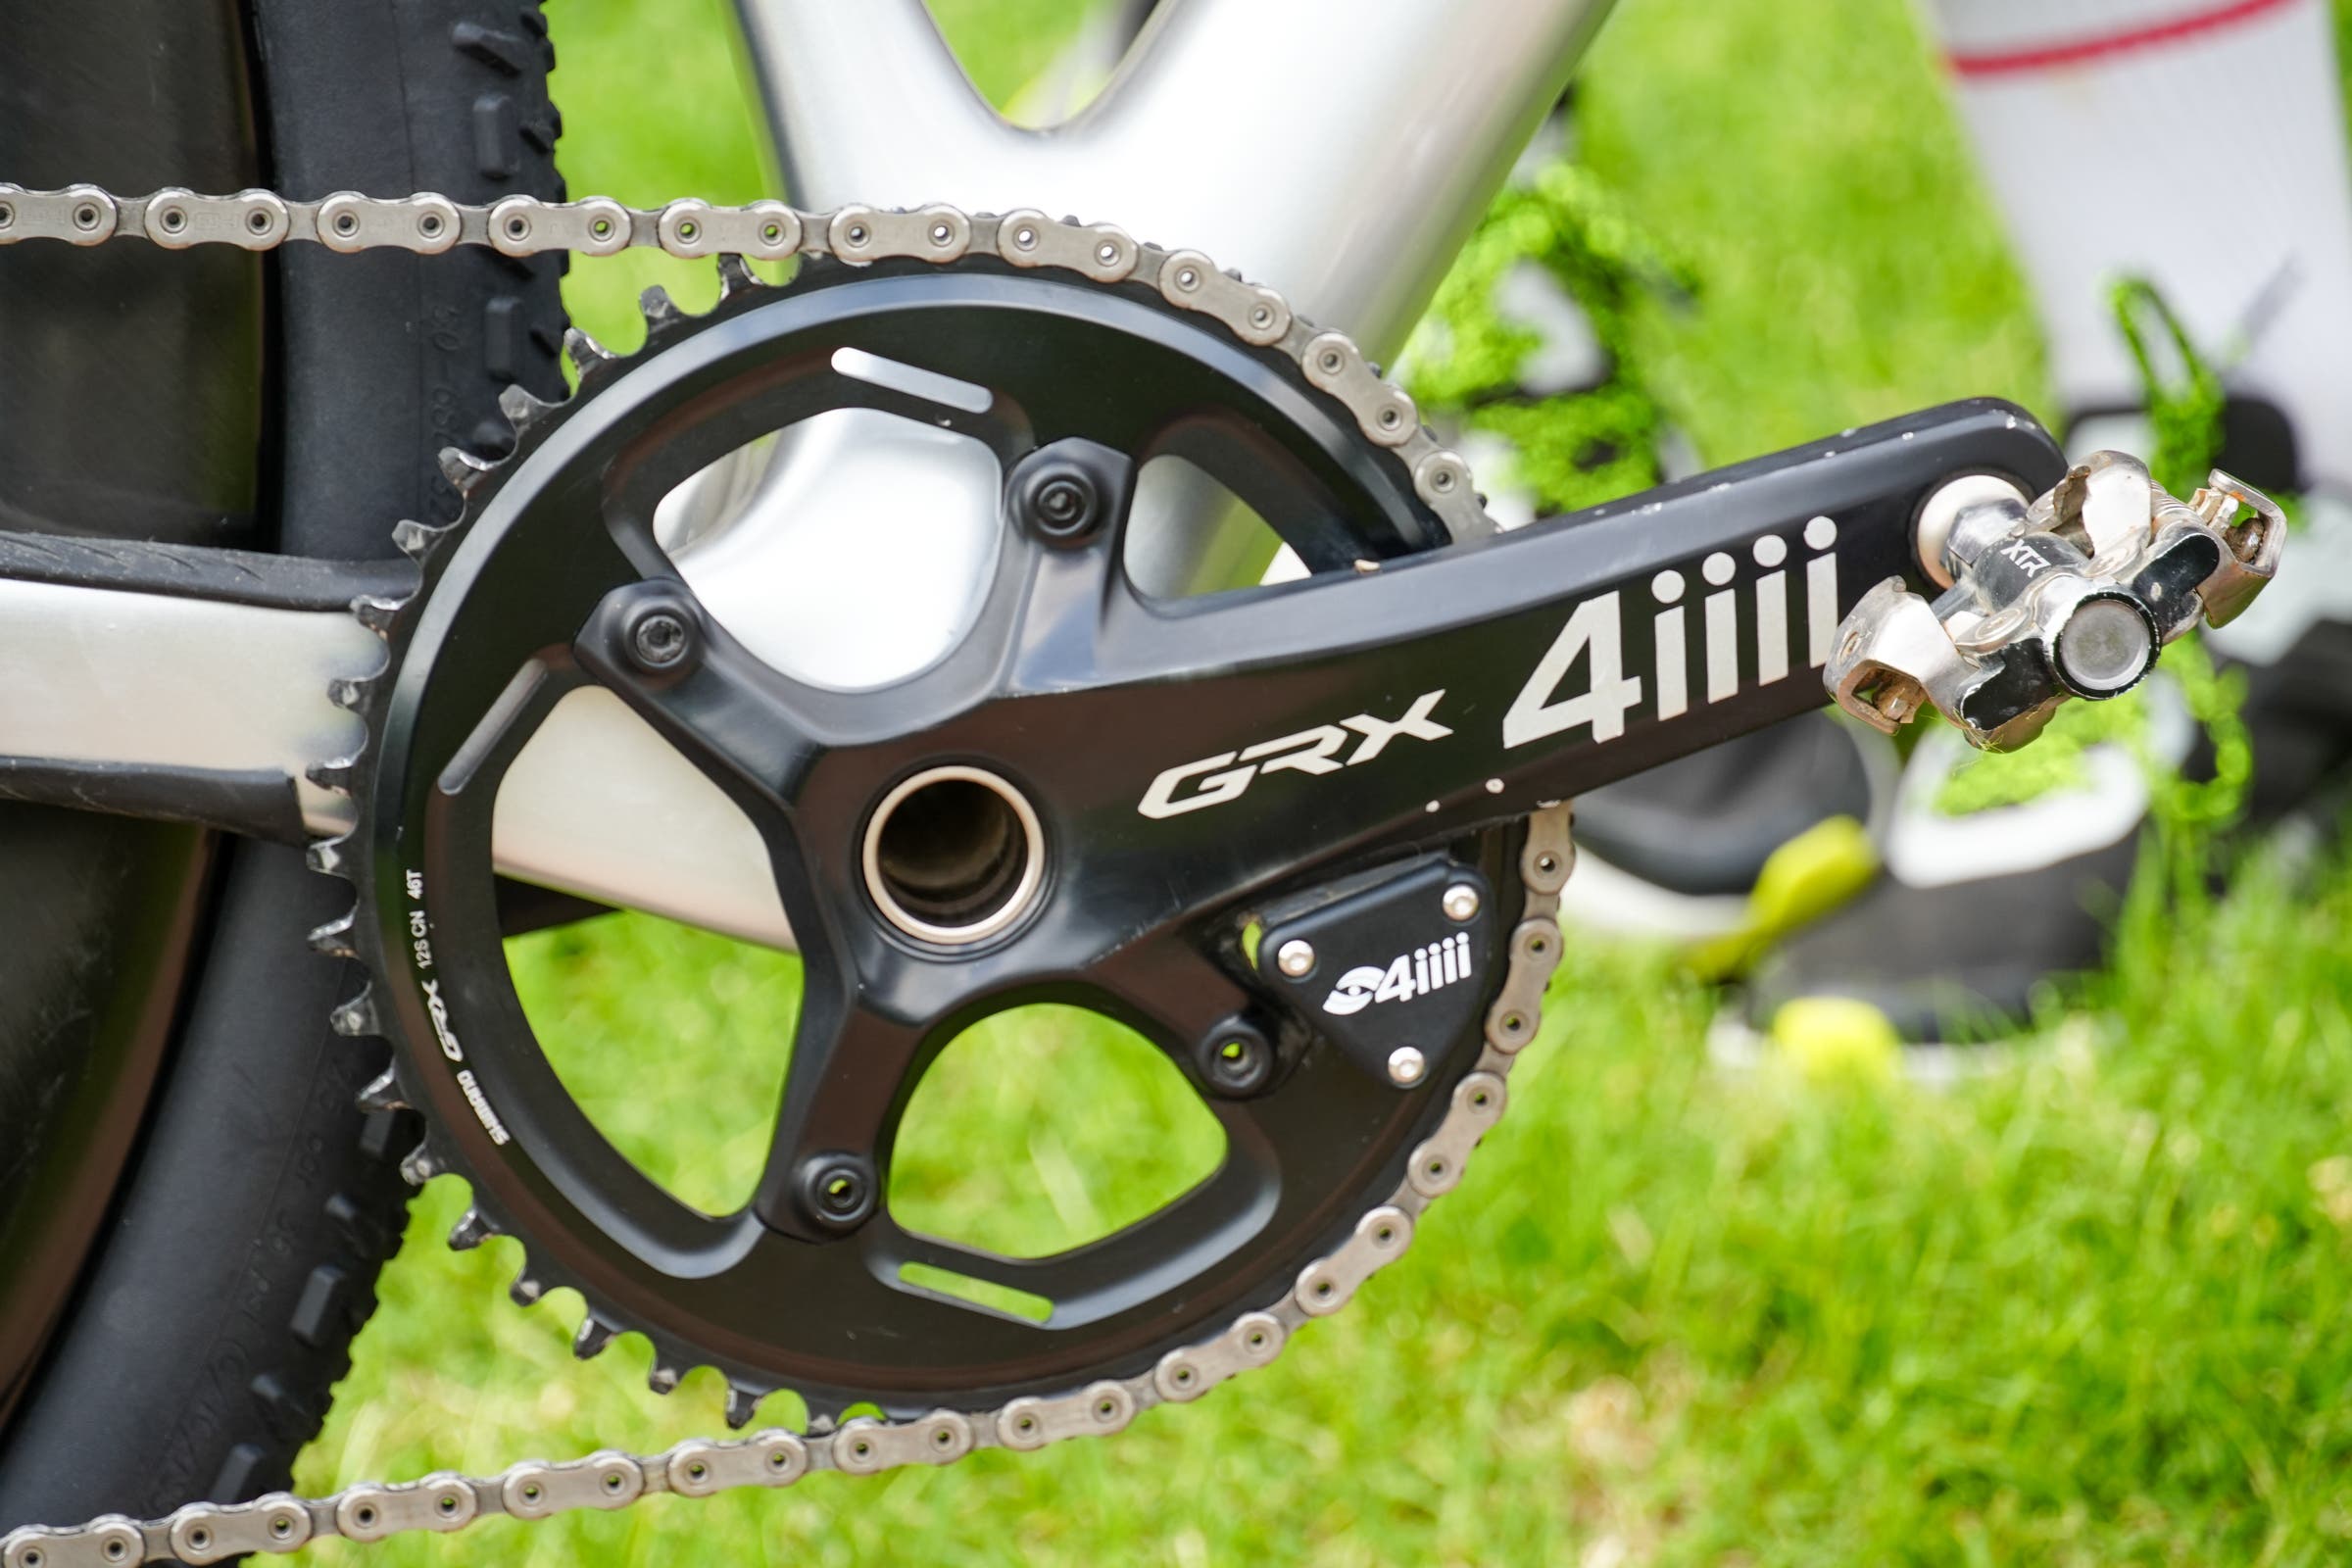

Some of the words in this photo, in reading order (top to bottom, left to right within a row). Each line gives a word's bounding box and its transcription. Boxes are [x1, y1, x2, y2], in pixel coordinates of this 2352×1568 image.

[2000, 539, 2052, 578] XTR
[1138, 688, 1453, 819] GRX
[1502, 515, 1838, 749] 4iiii
[406, 868, 423, 900] 46T
[421, 979, 464, 1062] GRX
[457, 1069, 511, 1146] SHIMANO
